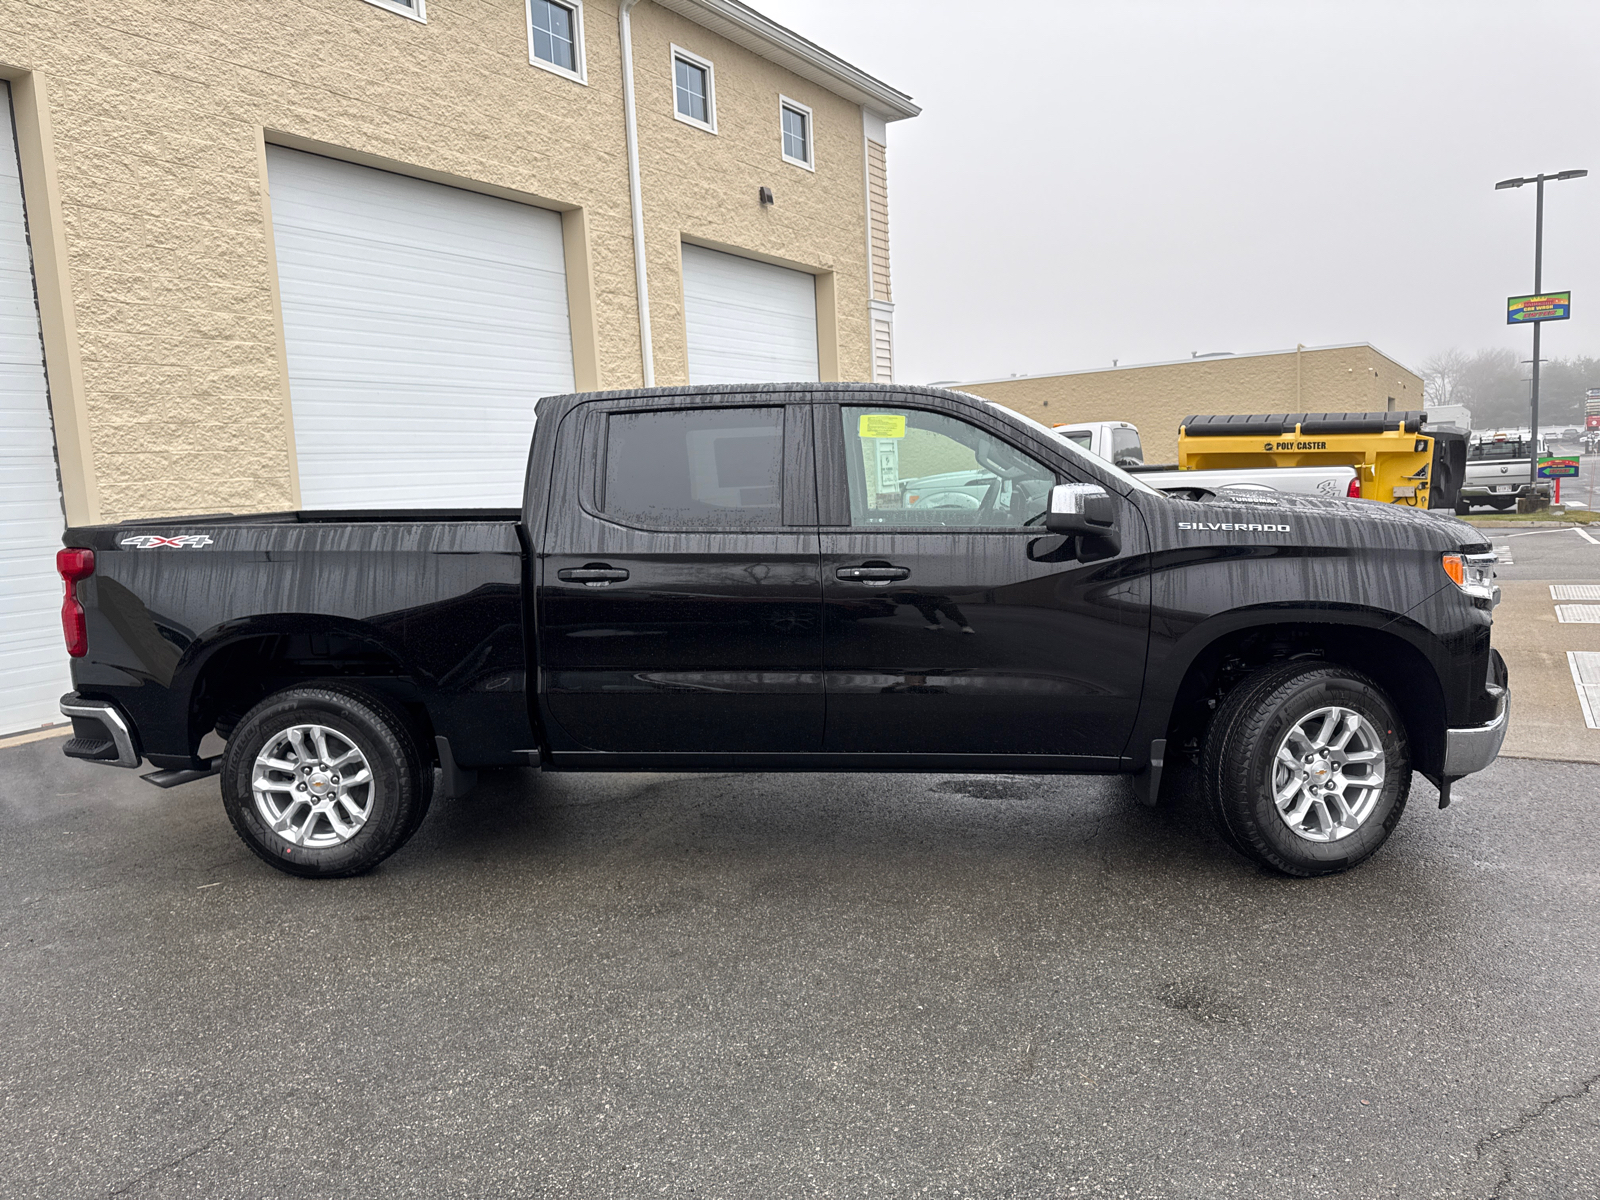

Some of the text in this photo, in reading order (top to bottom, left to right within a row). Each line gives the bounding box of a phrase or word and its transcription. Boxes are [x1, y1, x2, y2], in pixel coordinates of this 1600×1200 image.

[1523, 310, 1557, 318] ENTER
[1276, 442, 1326, 450] POLY CASTER
[1178, 522, 1290, 532] SILVERADO
[229, 723, 256, 780] MICHELIN
